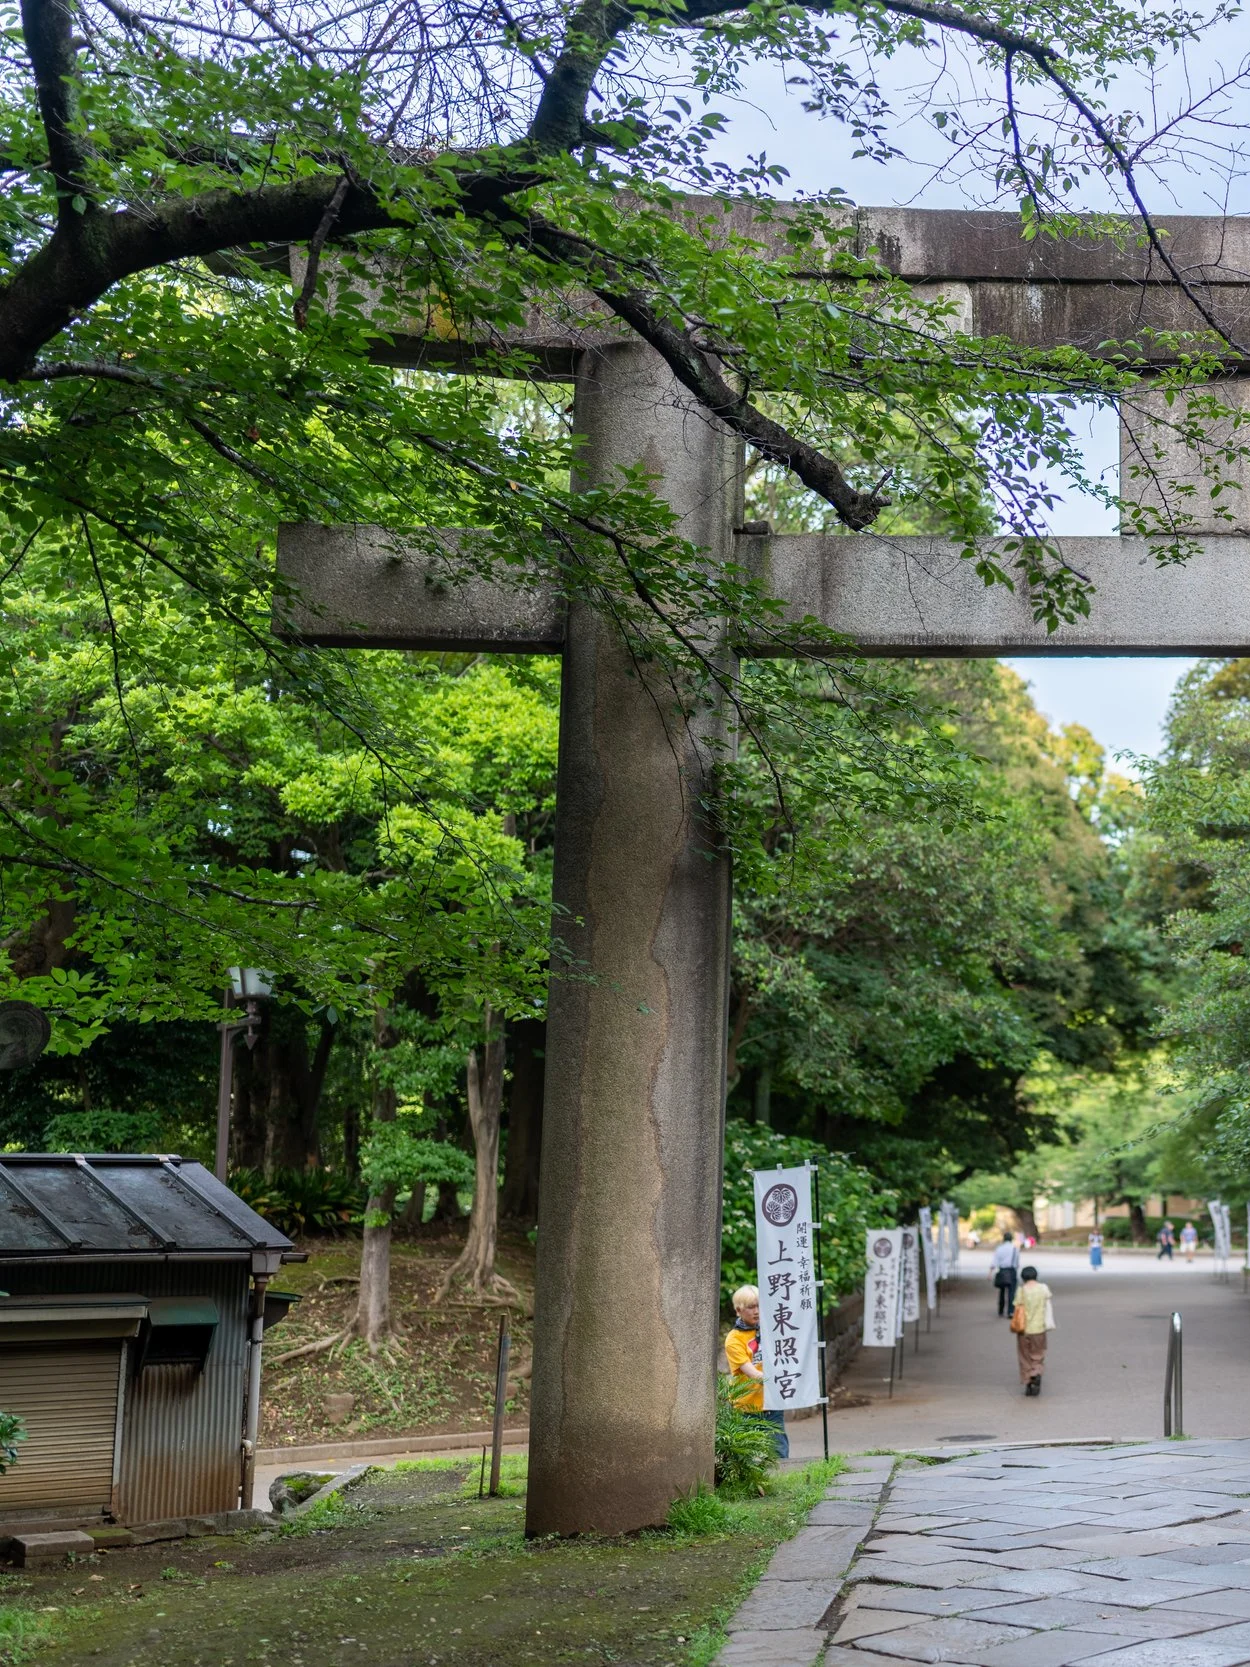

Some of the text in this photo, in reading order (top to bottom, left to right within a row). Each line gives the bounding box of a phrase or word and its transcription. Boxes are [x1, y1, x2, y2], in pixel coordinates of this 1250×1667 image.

[768, 1239, 802, 1400] 上野東照宮
[873, 1263, 889, 1341] 上野東照宮
